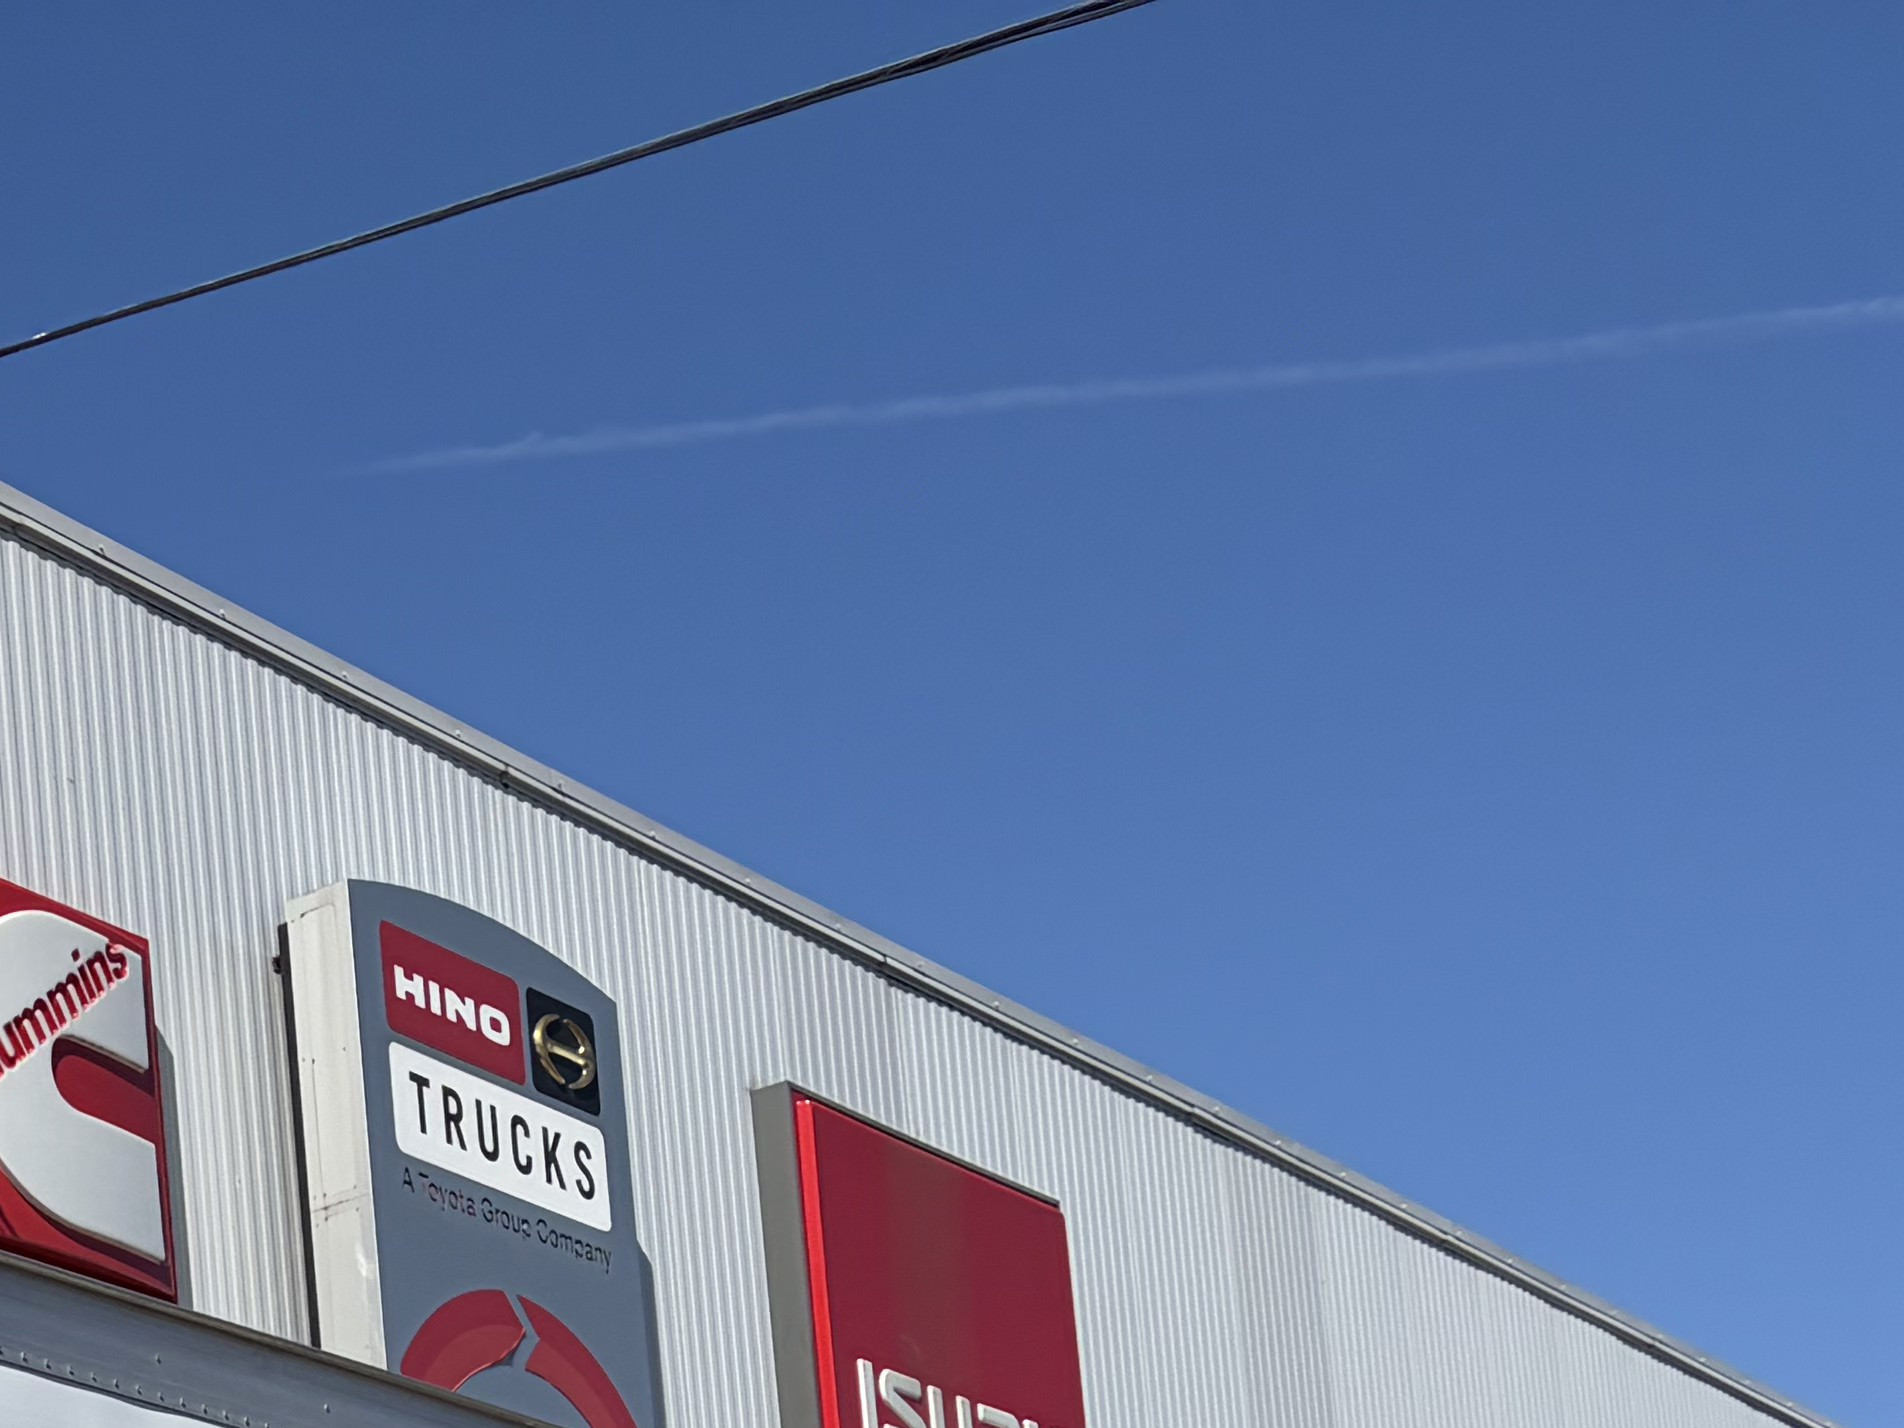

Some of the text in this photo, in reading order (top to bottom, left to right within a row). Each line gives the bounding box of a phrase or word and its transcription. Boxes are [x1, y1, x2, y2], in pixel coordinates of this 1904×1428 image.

[394, 965, 510, 1046] HINO
[409, 1071, 596, 1200] TRUCKS
[402, 1167, 415, 1193] A
